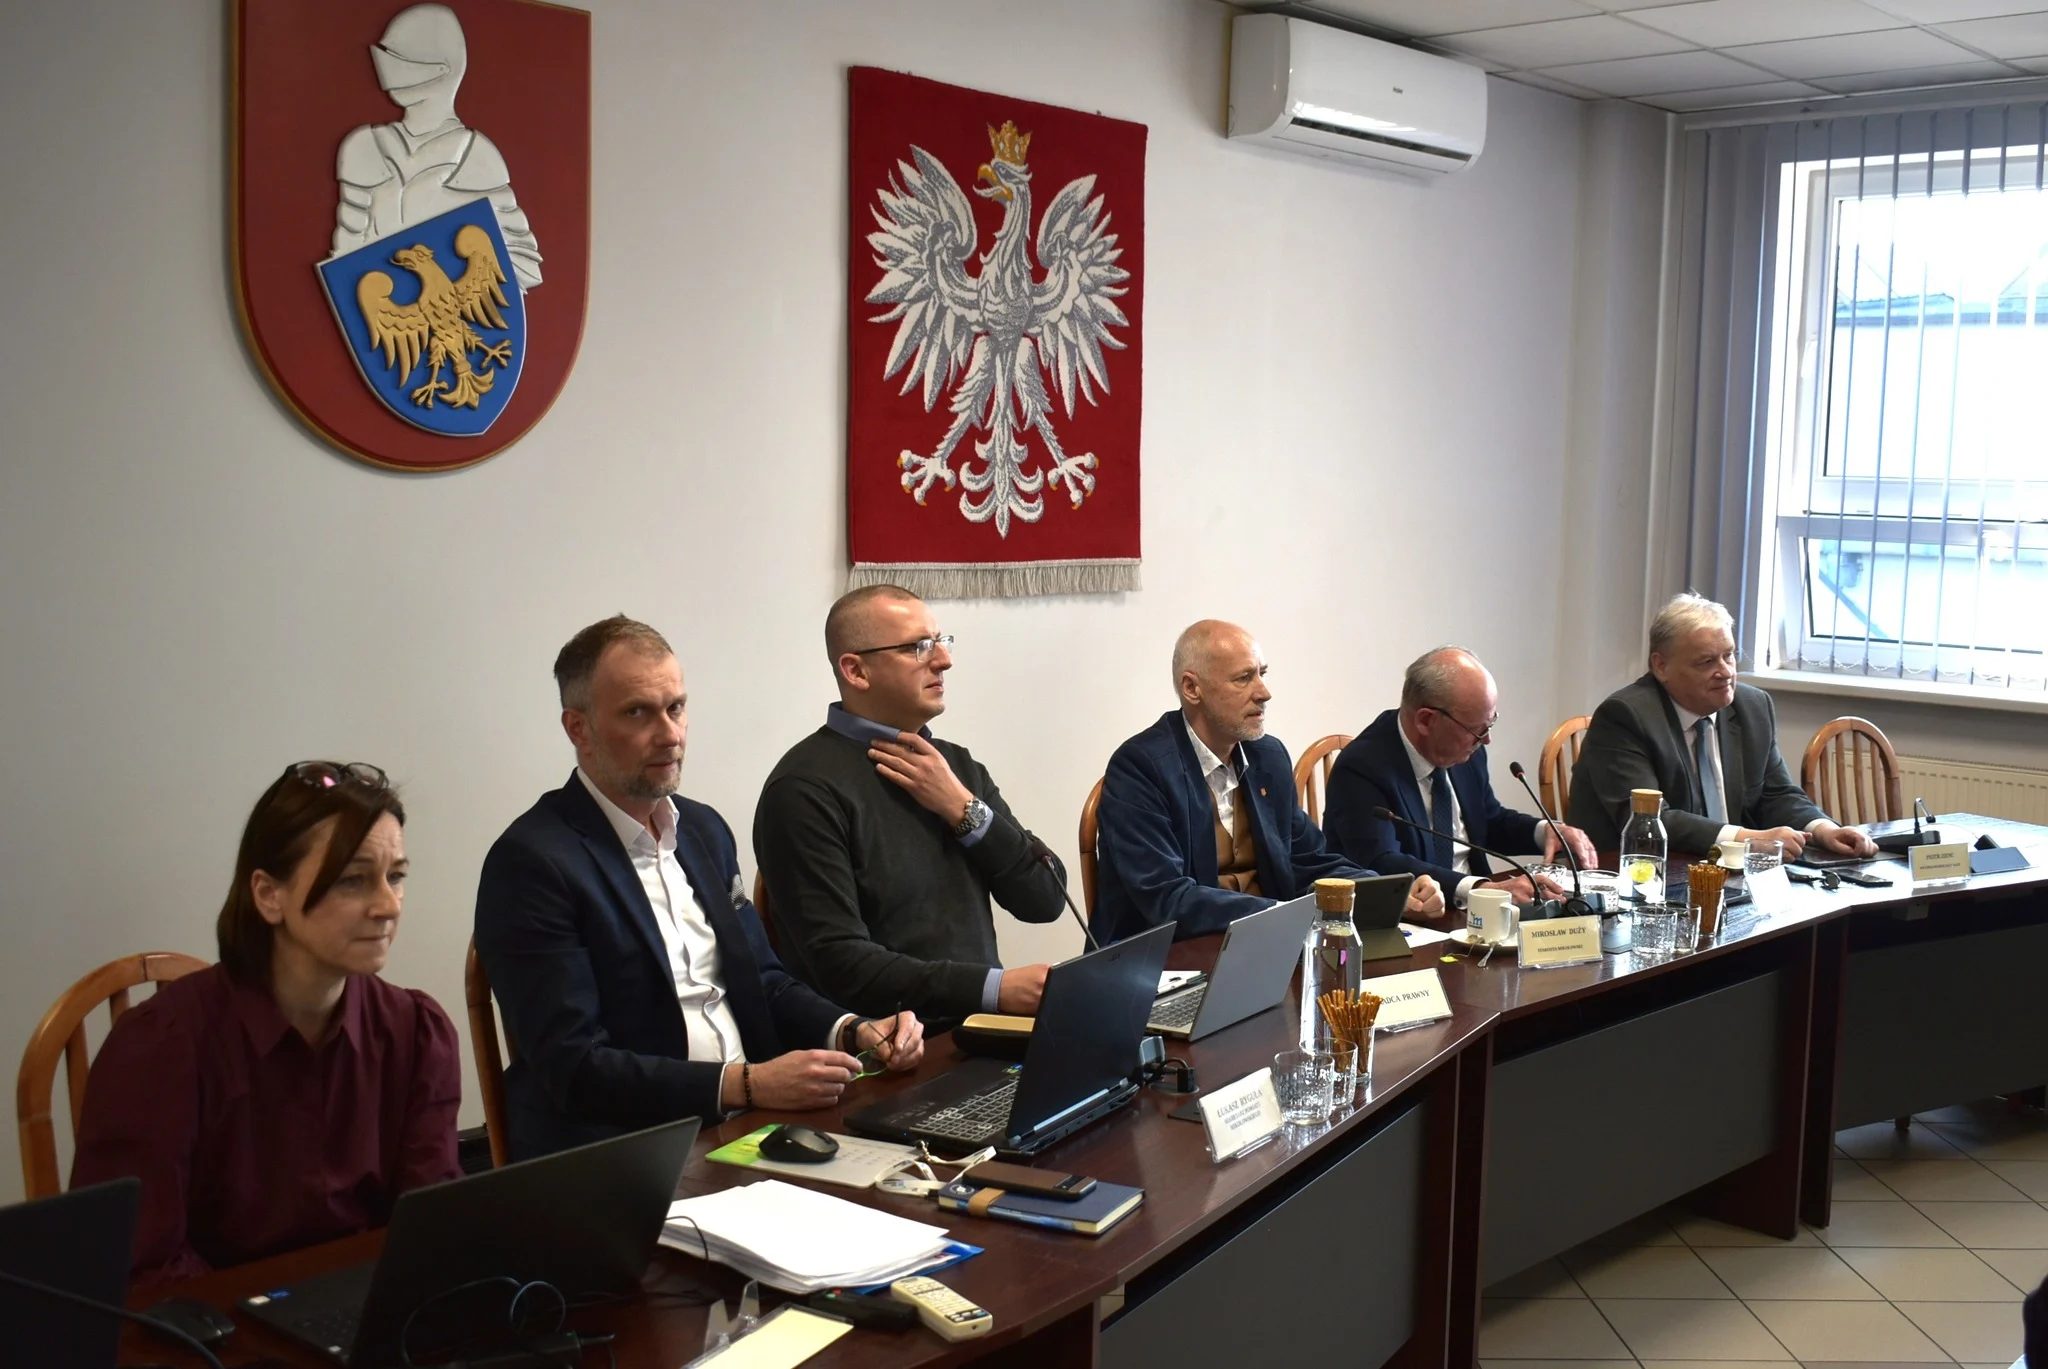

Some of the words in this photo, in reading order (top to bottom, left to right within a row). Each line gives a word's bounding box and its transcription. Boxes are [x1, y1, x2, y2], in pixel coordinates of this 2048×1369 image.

[1531, 929, 1567, 938] MIROSŁAW
[1569, 927, 1586, 935] DUŻY
[1381, 995, 1401, 1005] ADCA
[1402, 989, 1430, 1001] PRAWNY
[1217, 1101, 1240, 1118] ŁUKASZ
